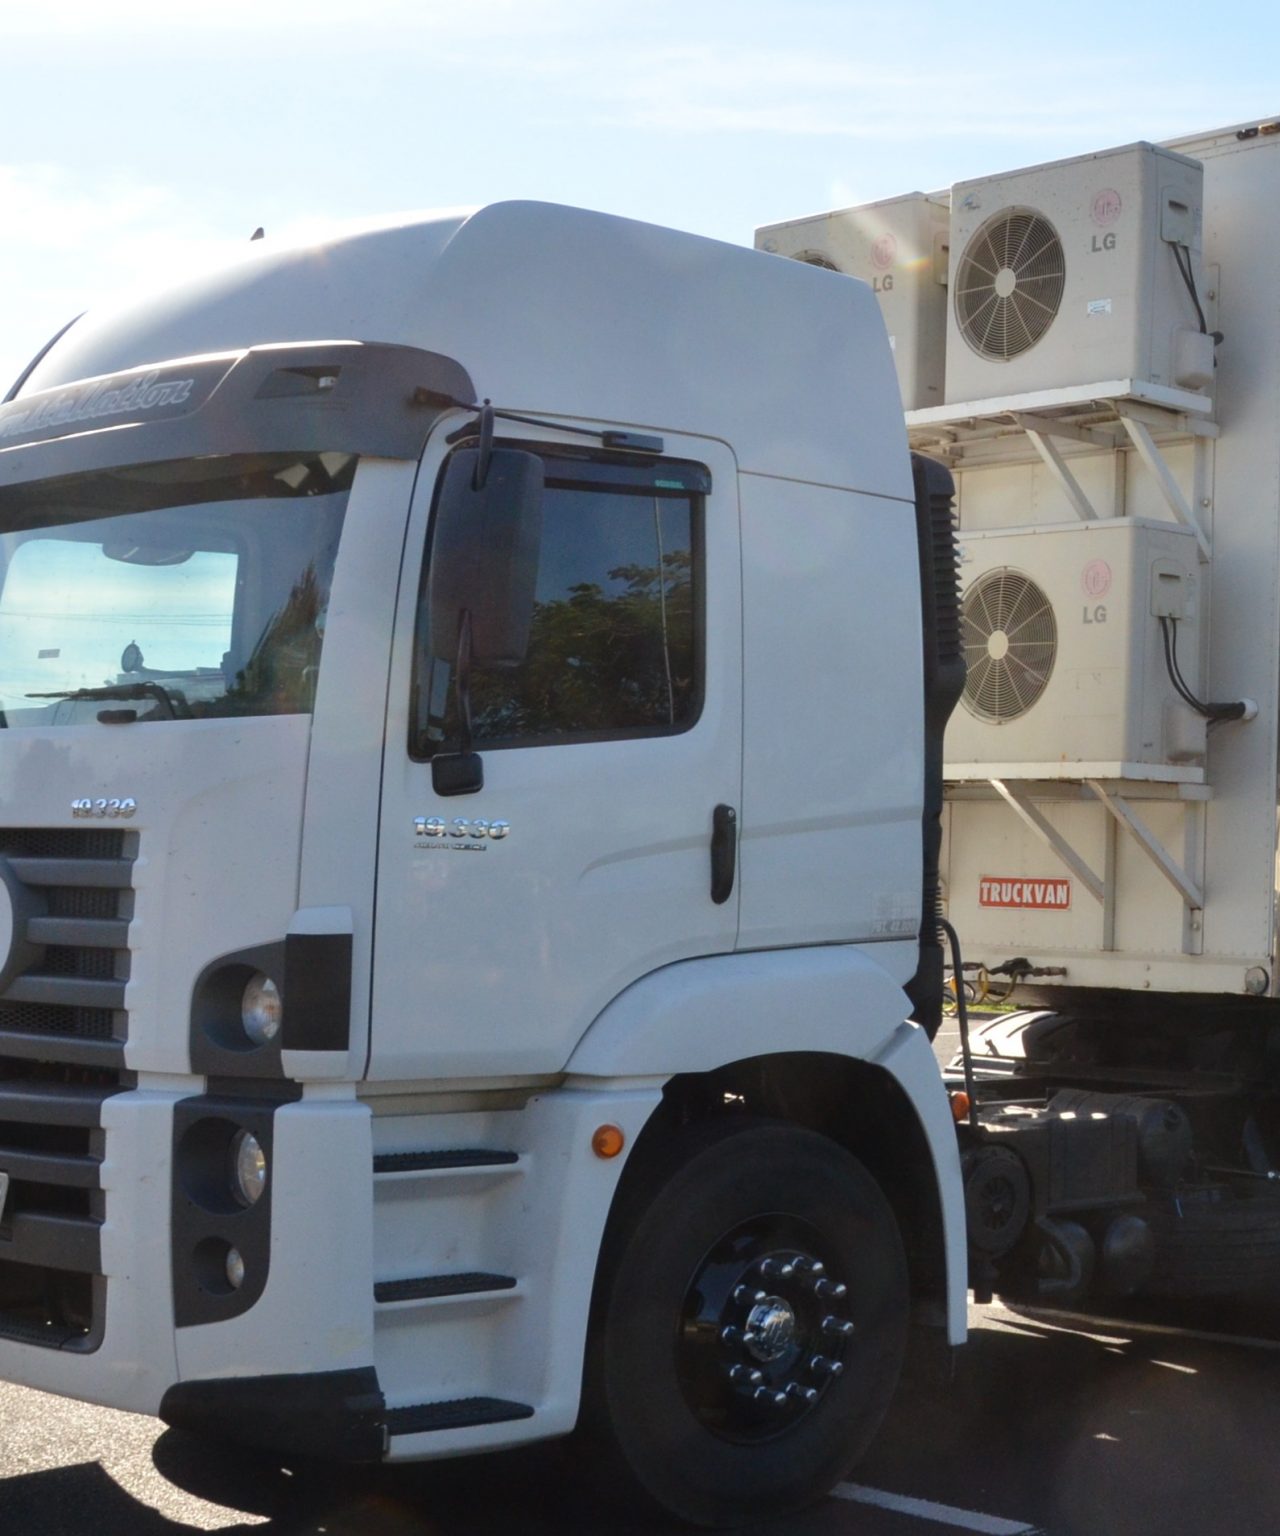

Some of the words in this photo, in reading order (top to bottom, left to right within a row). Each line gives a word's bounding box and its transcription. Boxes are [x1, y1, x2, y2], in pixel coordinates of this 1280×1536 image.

[1091, 232, 1116, 253] LG
[872, 273, 894, 293] LG
[1081, 604, 1108, 625] LG
[71, 797, 138, 820] 19.330
[412, 815, 511, 841] 19.330
[981, 881, 1069, 905] TRUCKVAN
